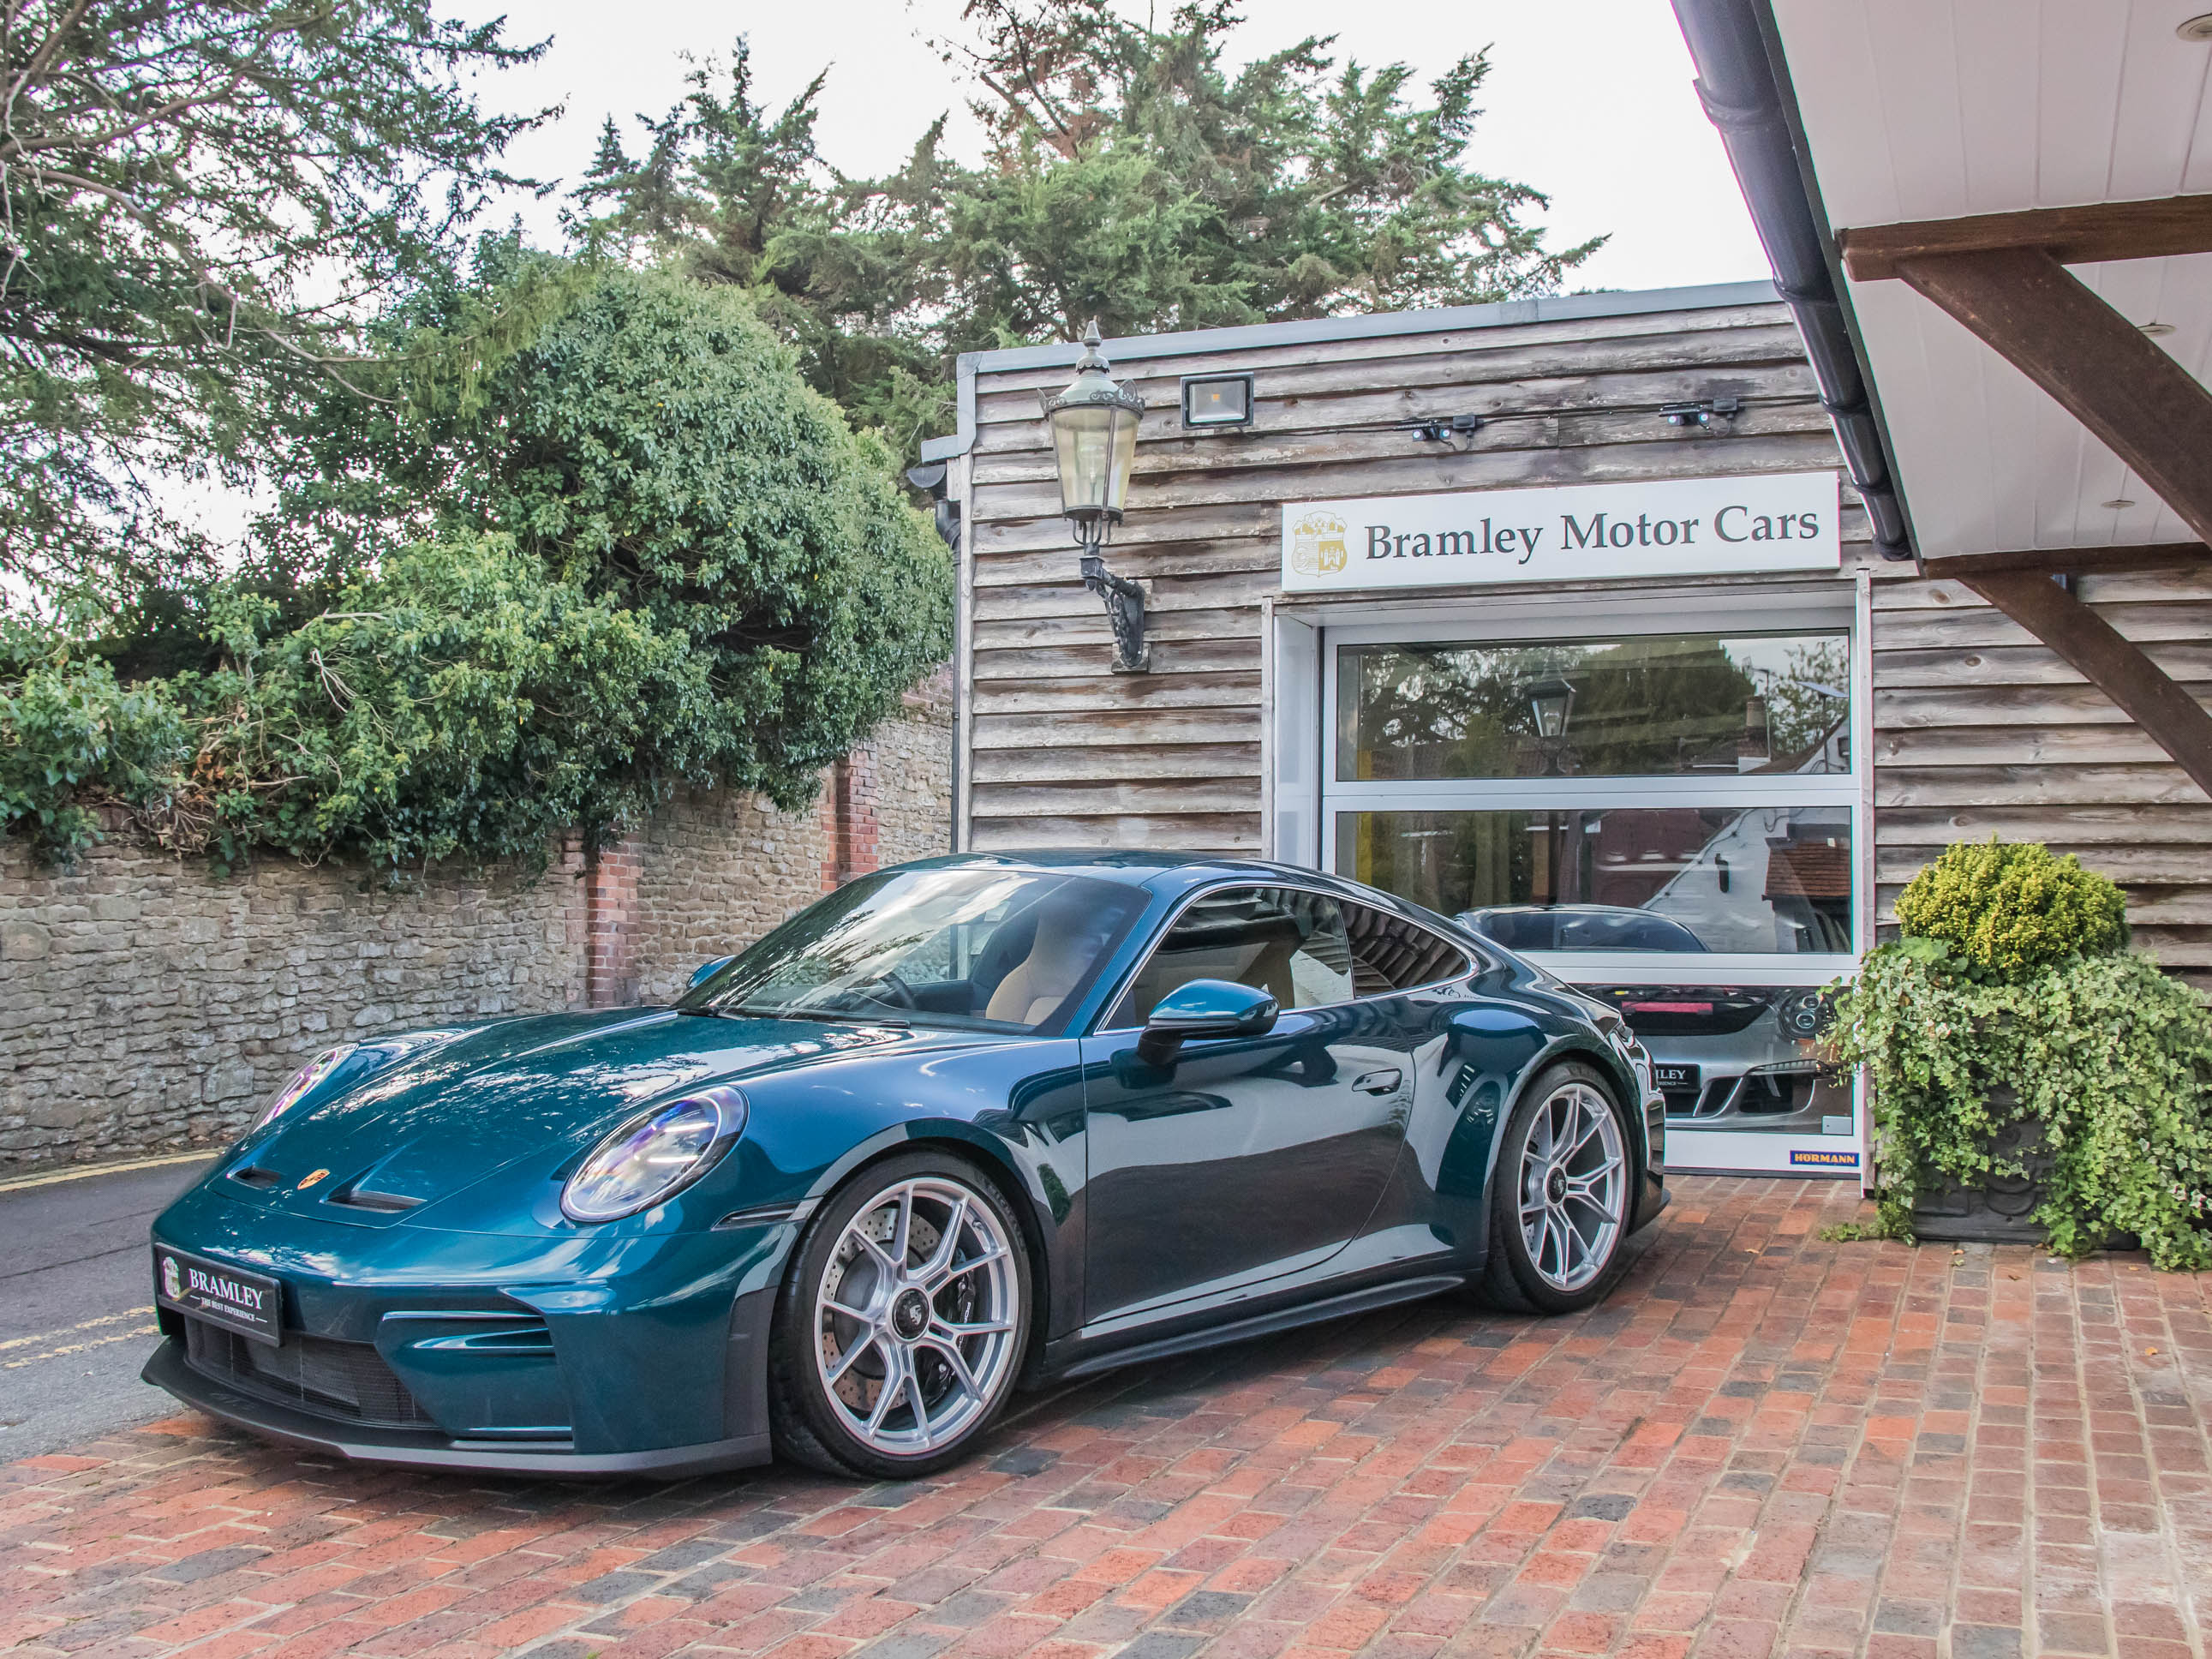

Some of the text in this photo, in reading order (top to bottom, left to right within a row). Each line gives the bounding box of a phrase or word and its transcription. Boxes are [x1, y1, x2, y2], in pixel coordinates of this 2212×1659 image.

[1365, 505, 1820, 565] Bramley Motor Cars
[188, 1268, 263, 1309] BRAMLEY
